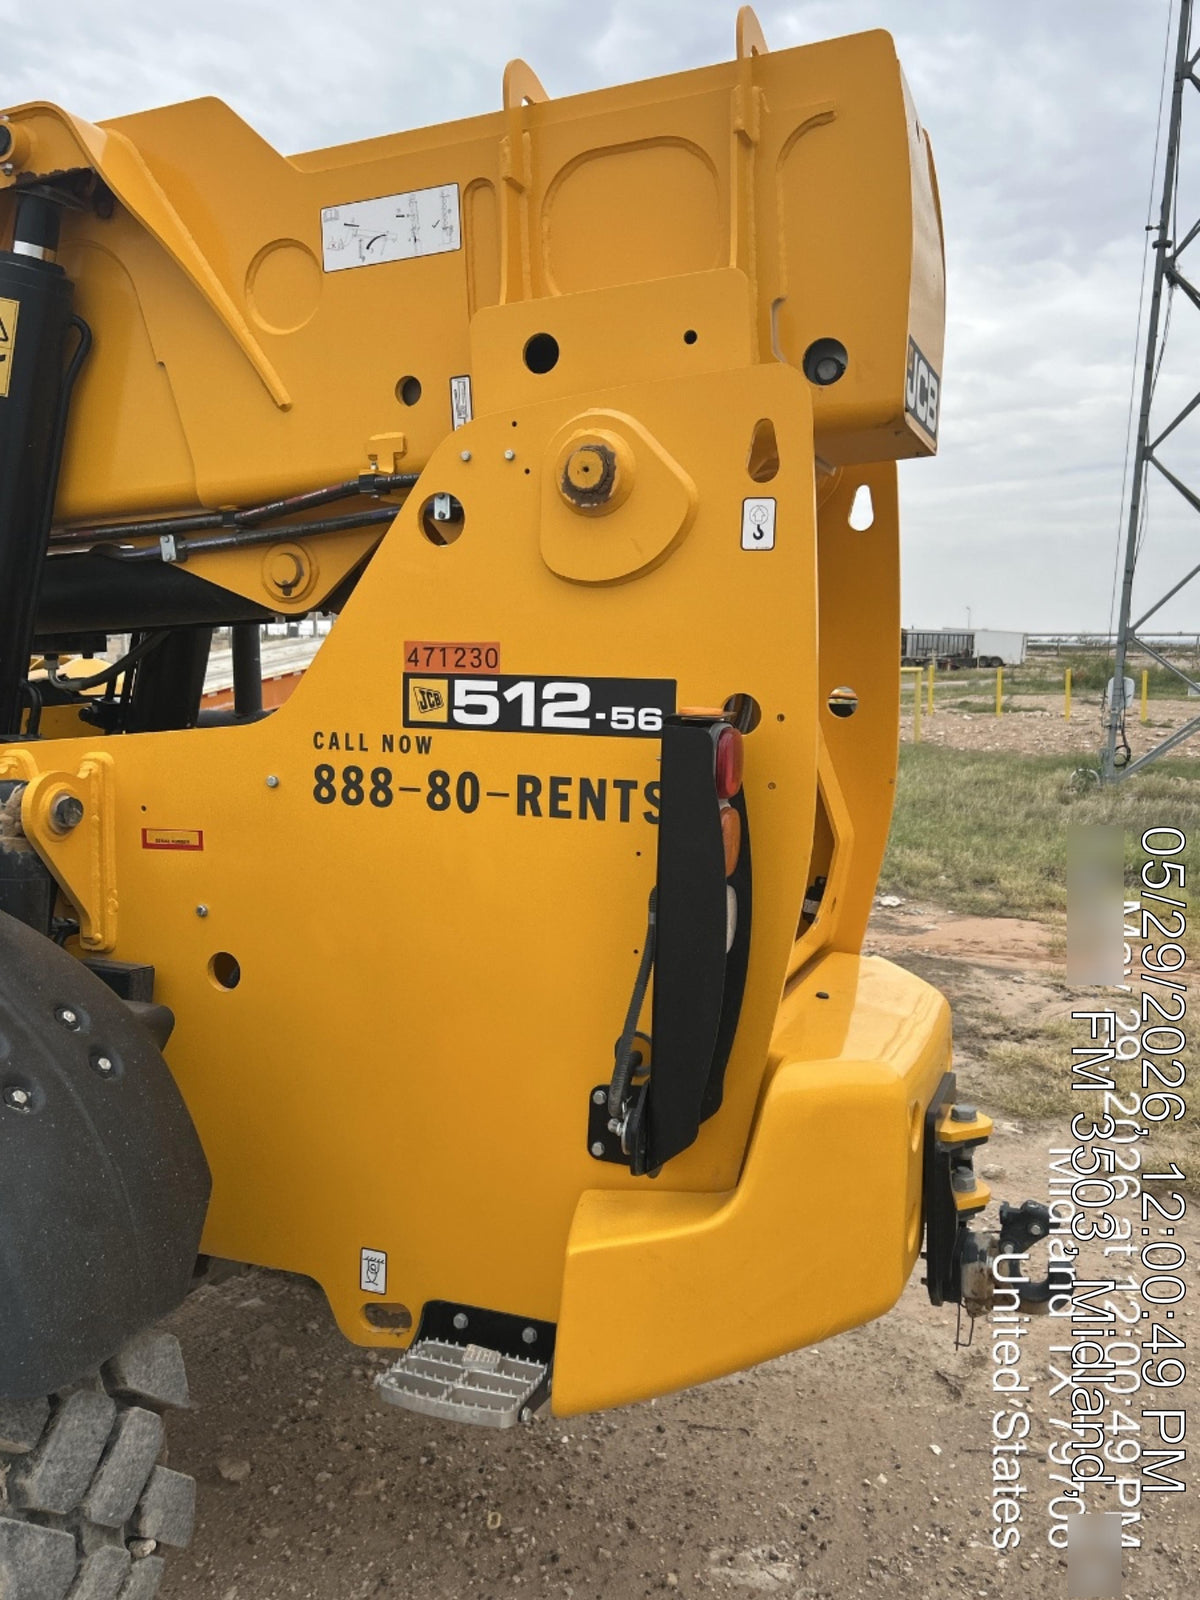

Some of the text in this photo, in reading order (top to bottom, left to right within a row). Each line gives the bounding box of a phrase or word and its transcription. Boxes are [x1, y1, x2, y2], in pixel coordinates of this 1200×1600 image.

[907, 351, 939, 433] JCB
[407, 647, 499, 669] 471230
[417, 686, 443, 711] JCB
[313, 731, 432, 754] CALL NOW
